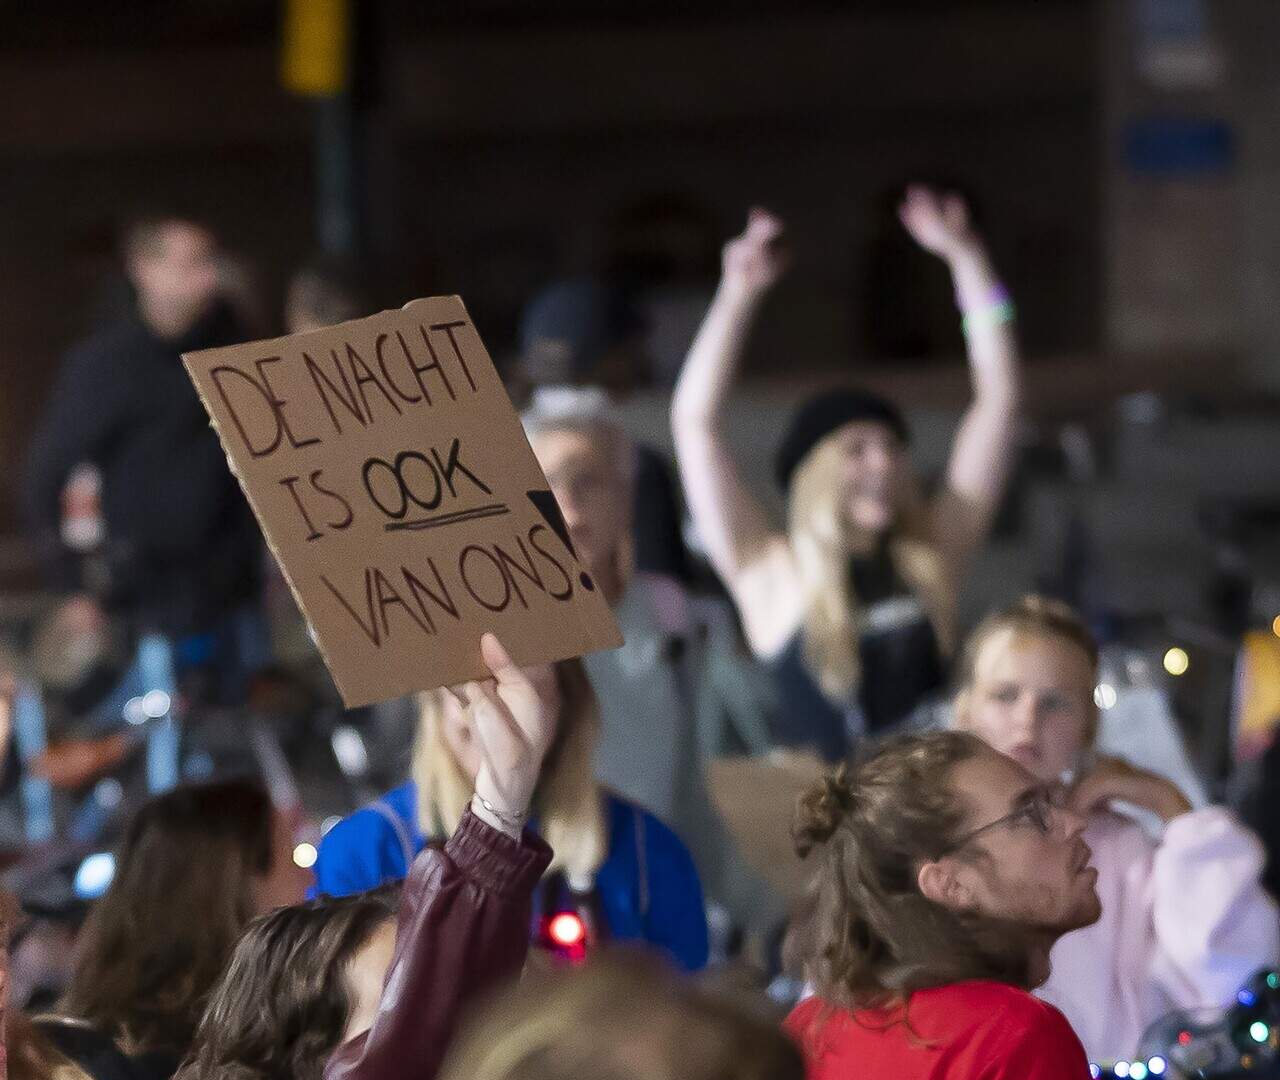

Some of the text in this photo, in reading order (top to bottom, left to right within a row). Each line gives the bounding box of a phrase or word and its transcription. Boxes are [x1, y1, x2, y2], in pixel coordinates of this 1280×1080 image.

[210, 320, 479, 460] DE NACHT
[279, 438, 493, 543] IS OOK
[321, 557, 461, 649] VAN
